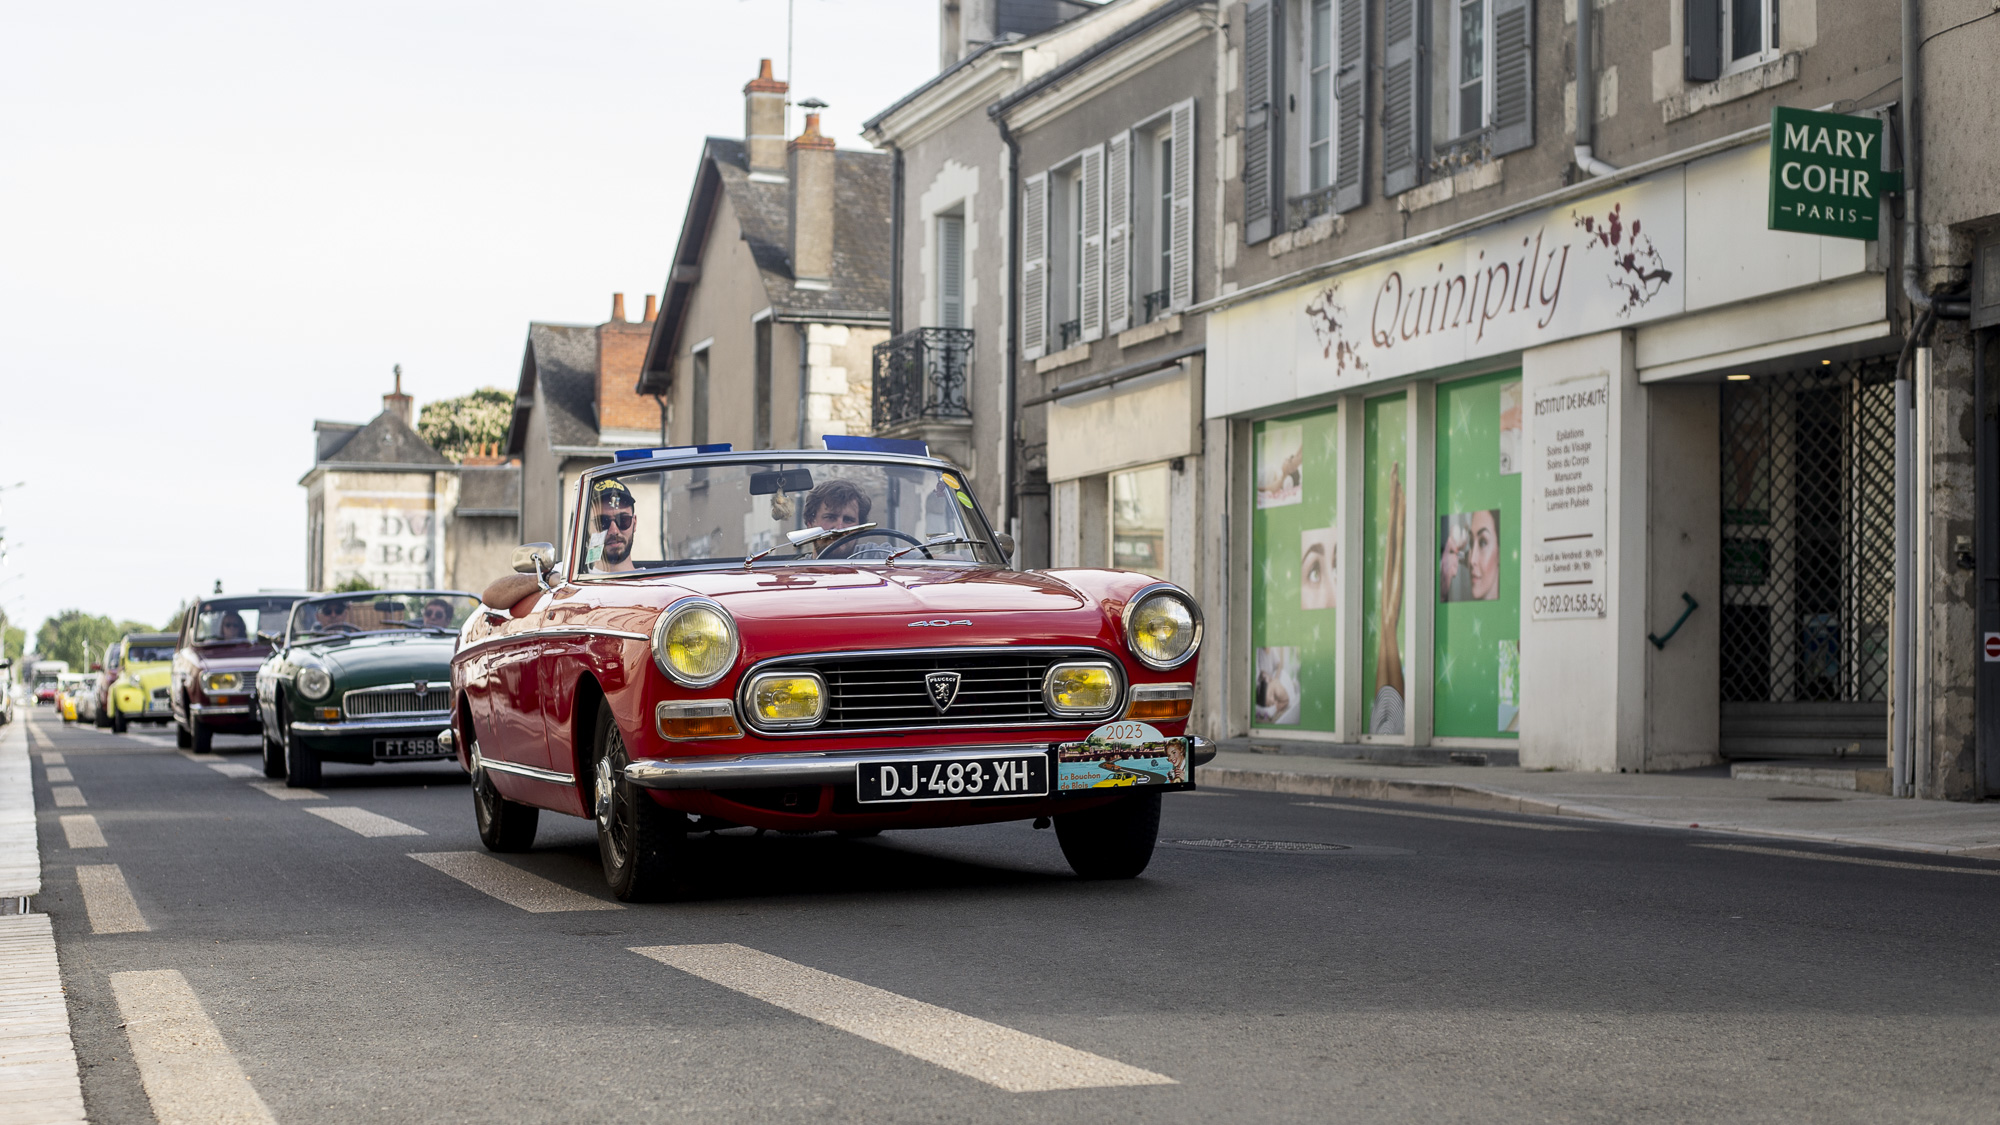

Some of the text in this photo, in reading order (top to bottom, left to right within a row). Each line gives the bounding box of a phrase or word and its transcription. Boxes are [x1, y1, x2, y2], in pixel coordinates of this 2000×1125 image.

[1783, 122, 1875, 159] MARY
[1781, 162, 1872, 198] COHR
[1372, 225, 1571, 348] Quinipily
[1535, 384, 1606, 416] INSTITUT DE BEAUTÉ
[1556, 429, 1584, 442] Epilations
[1547, 441, 1592, 457] Soins du Visage
[1547, 455, 1590, 471] Soins du Corps
[1554, 471, 1582, 482] Manucure
[1544, 482, 1593, 498] Beauté des pieds
[1547, 496, 1590, 512] Lumière Pulsée
[907, 619, 973, 627] 404
[1106, 724, 1143, 740] 2023
[880, 760, 1029, 797] DJ-483-XH
[1070, 771, 1101, 781] Bouchon
[1060, 781, 1089, 790] de Blois
